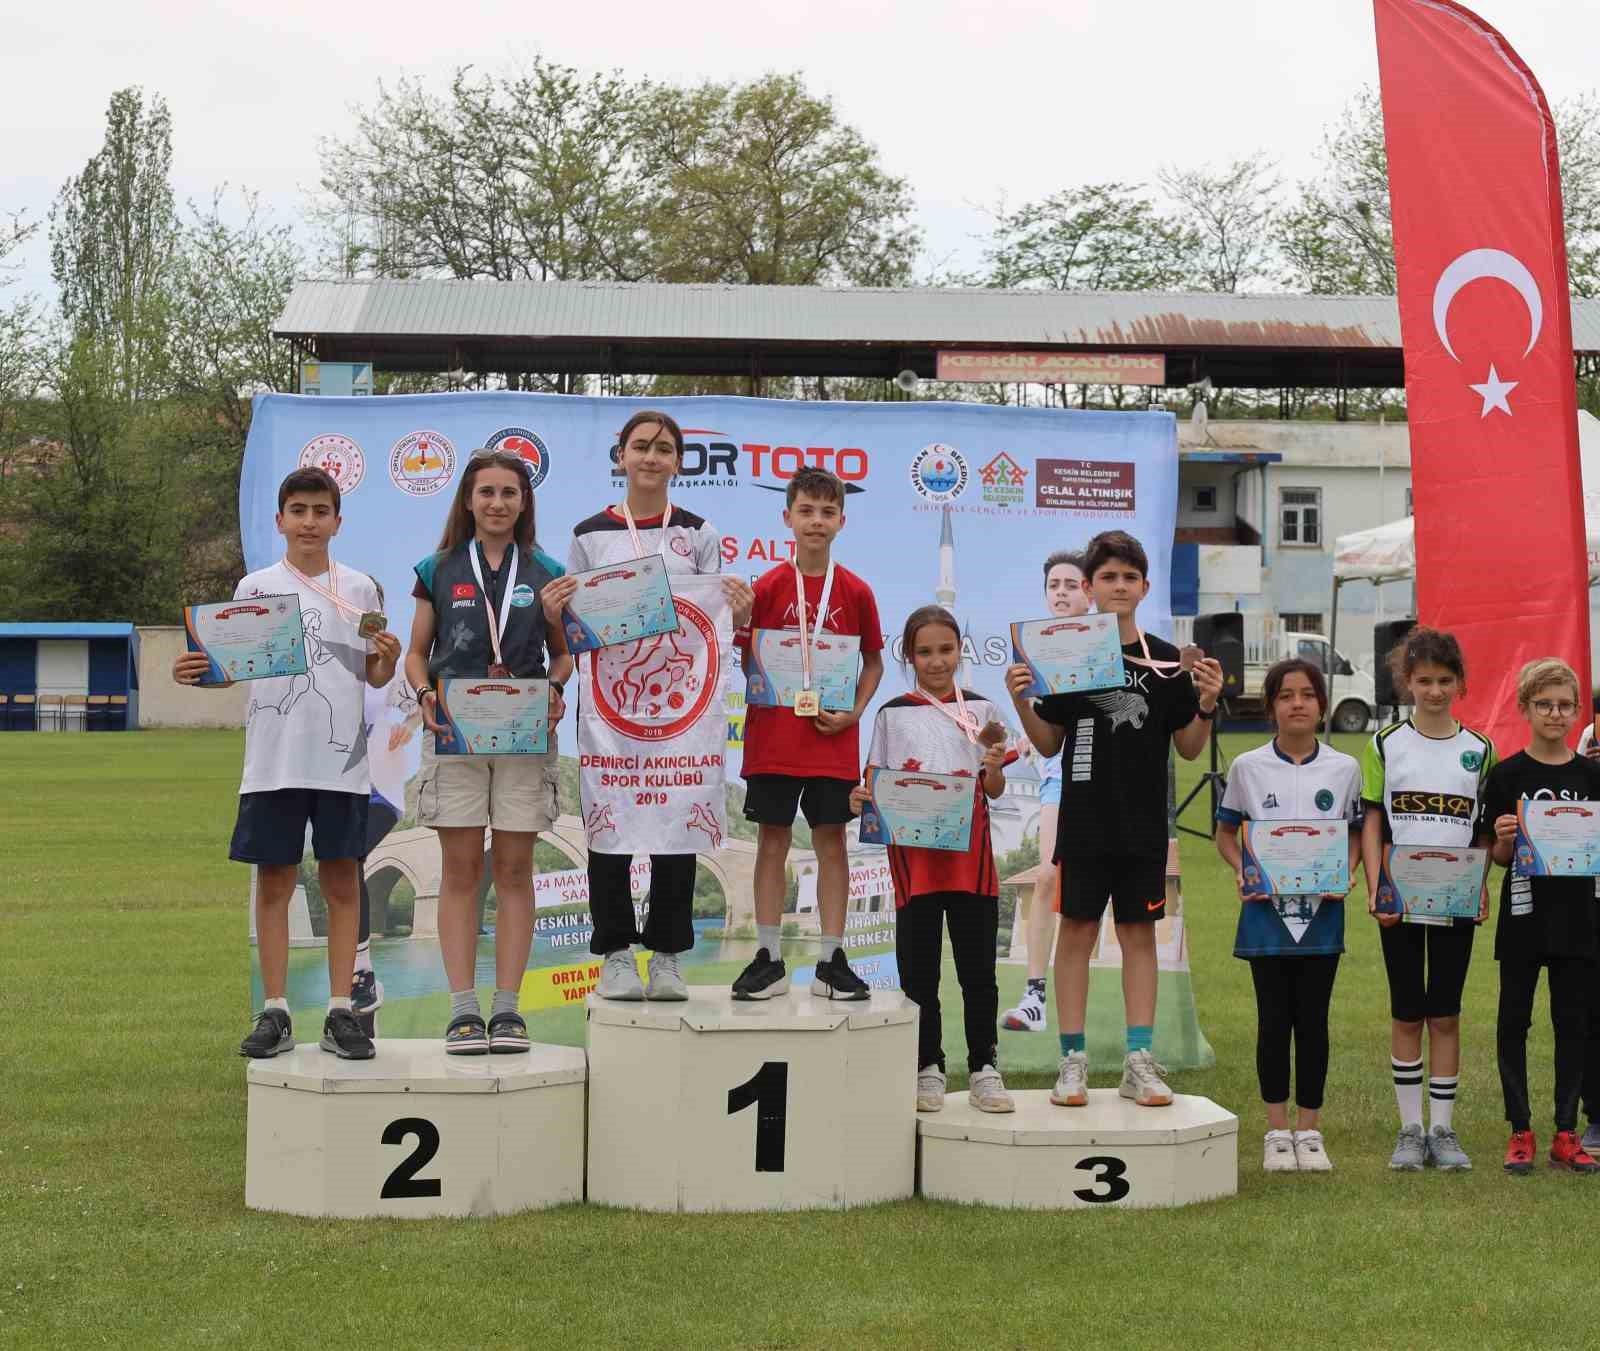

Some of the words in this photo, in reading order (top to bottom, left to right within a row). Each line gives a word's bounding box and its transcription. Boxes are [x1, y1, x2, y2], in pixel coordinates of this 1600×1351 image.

[742, 444, 869, 481] TOTO
[1041, 485, 1075, 496] CELAL
[1079, 488, 1133, 500] ALTINIŞIK
[580, 753, 639, 770] DEMİRCİ
[601, 774, 640, 788] SPOR
[645, 772, 703, 787] KULÜBÜ
[636, 793, 668, 805] 2019
[535, 879, 550, 891] 24
[554, 873, 588, 889] MAYI
[562, 889, 588, 902] SAA
[552, 969, 585, 985] ORTA
[728, 1062, 788, 1172] 1
[380, 1118, 441, 1199] 2
[1074, 1157, 1130, 1203] 3
